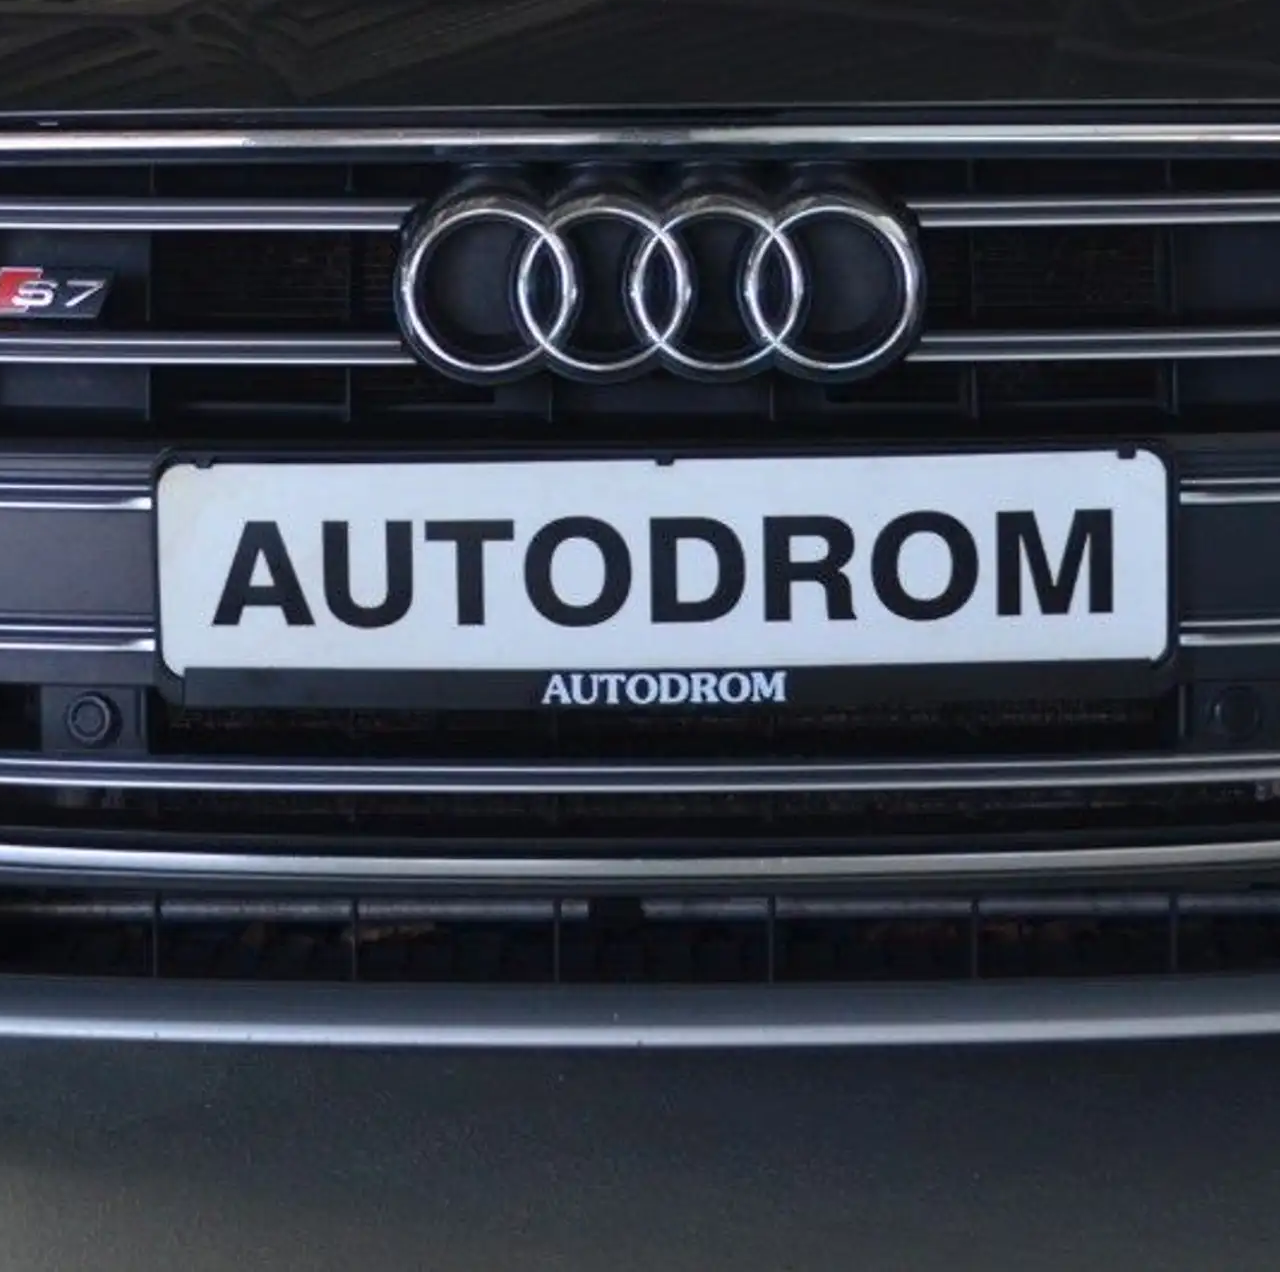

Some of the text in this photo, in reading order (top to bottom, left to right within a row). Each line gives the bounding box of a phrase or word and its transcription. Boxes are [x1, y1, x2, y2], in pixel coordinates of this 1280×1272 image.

[11, 280, 107, 307] S7
[211, 508, 1114, 629] AUTODROM
[541, 671, 788, 705] AUTODROM
